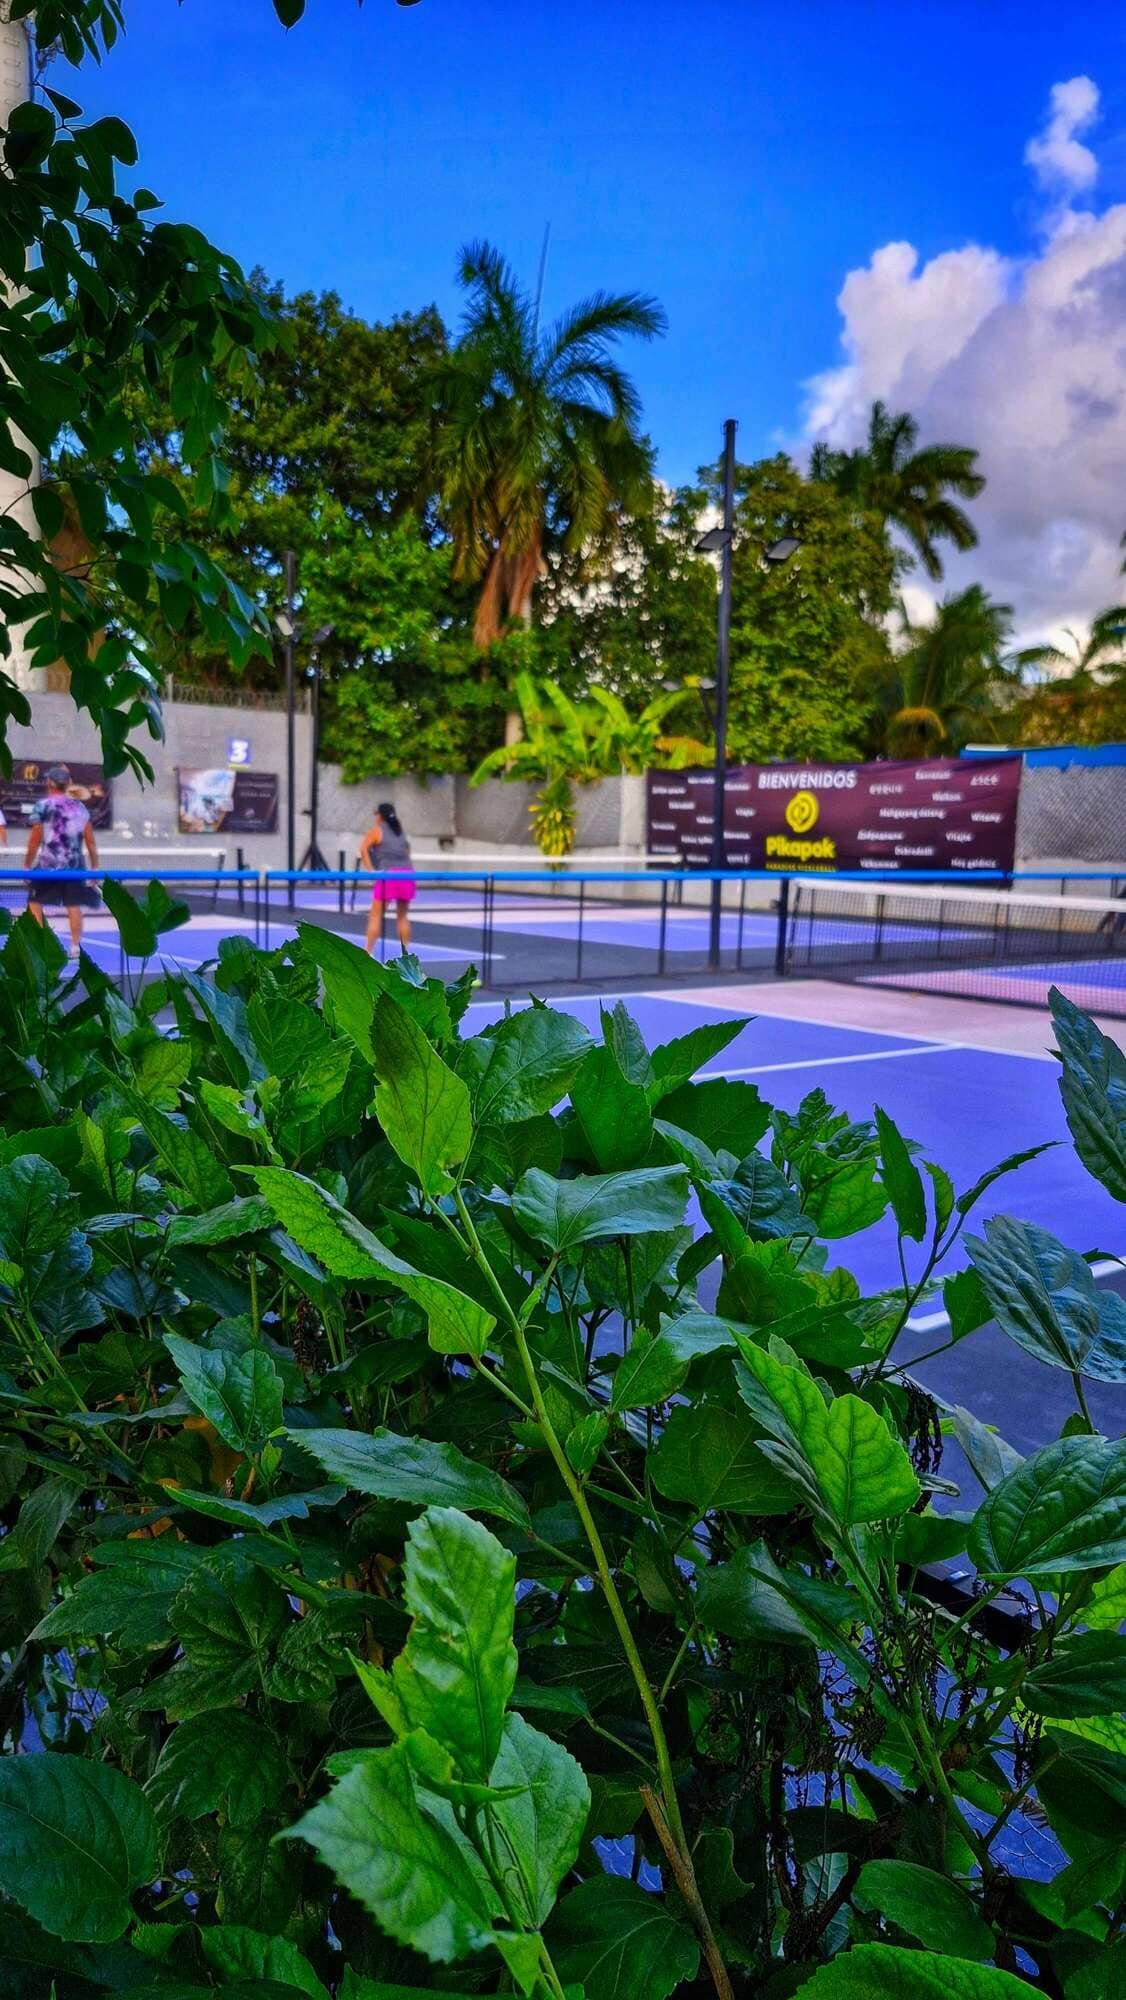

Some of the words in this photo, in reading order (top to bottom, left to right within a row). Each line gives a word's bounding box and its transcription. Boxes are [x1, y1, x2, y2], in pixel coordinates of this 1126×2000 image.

[230, 740, 249, 762] 3
[758, 770, 857, 790] BIENVENIDOS
[766, 835, 836, 861] Pikapok
